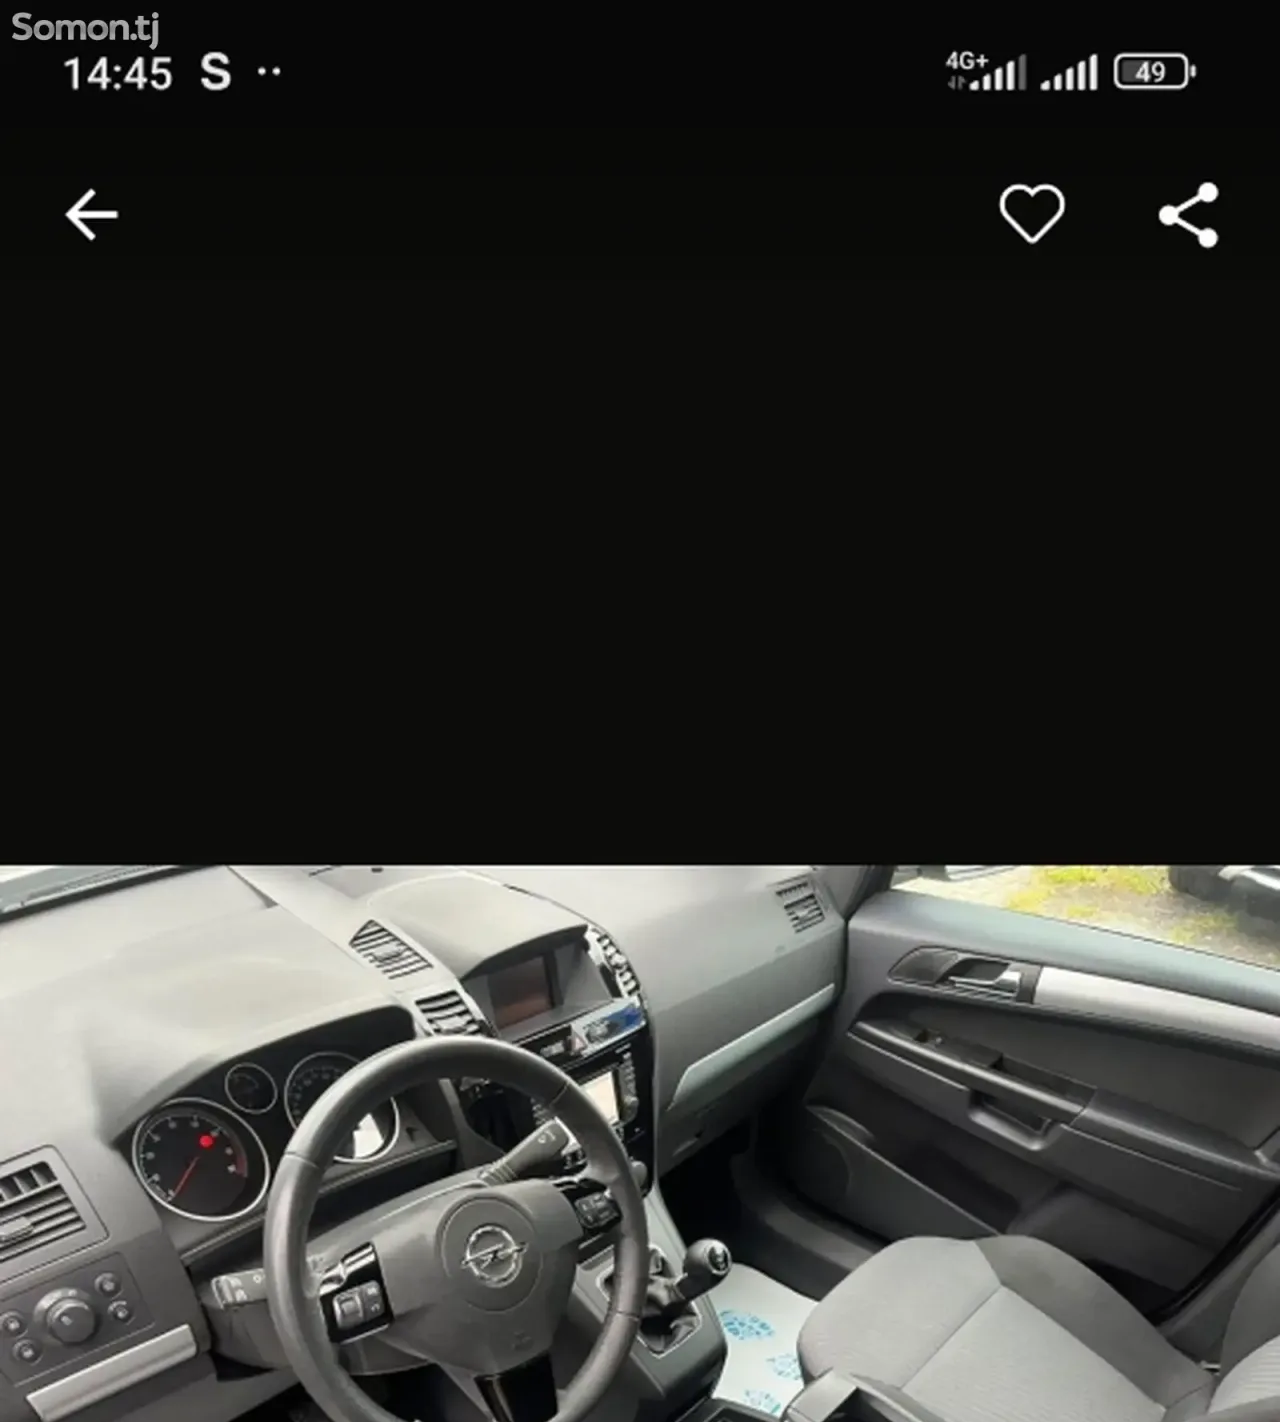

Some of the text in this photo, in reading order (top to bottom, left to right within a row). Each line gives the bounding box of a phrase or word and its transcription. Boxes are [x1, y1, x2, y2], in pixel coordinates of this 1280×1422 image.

[64, 57, 172, 90] 14:45
[201, 52, 231, 90] S
[946, 51, 989, 70] 4G+
[1135, 61, 1166, 83] 49
